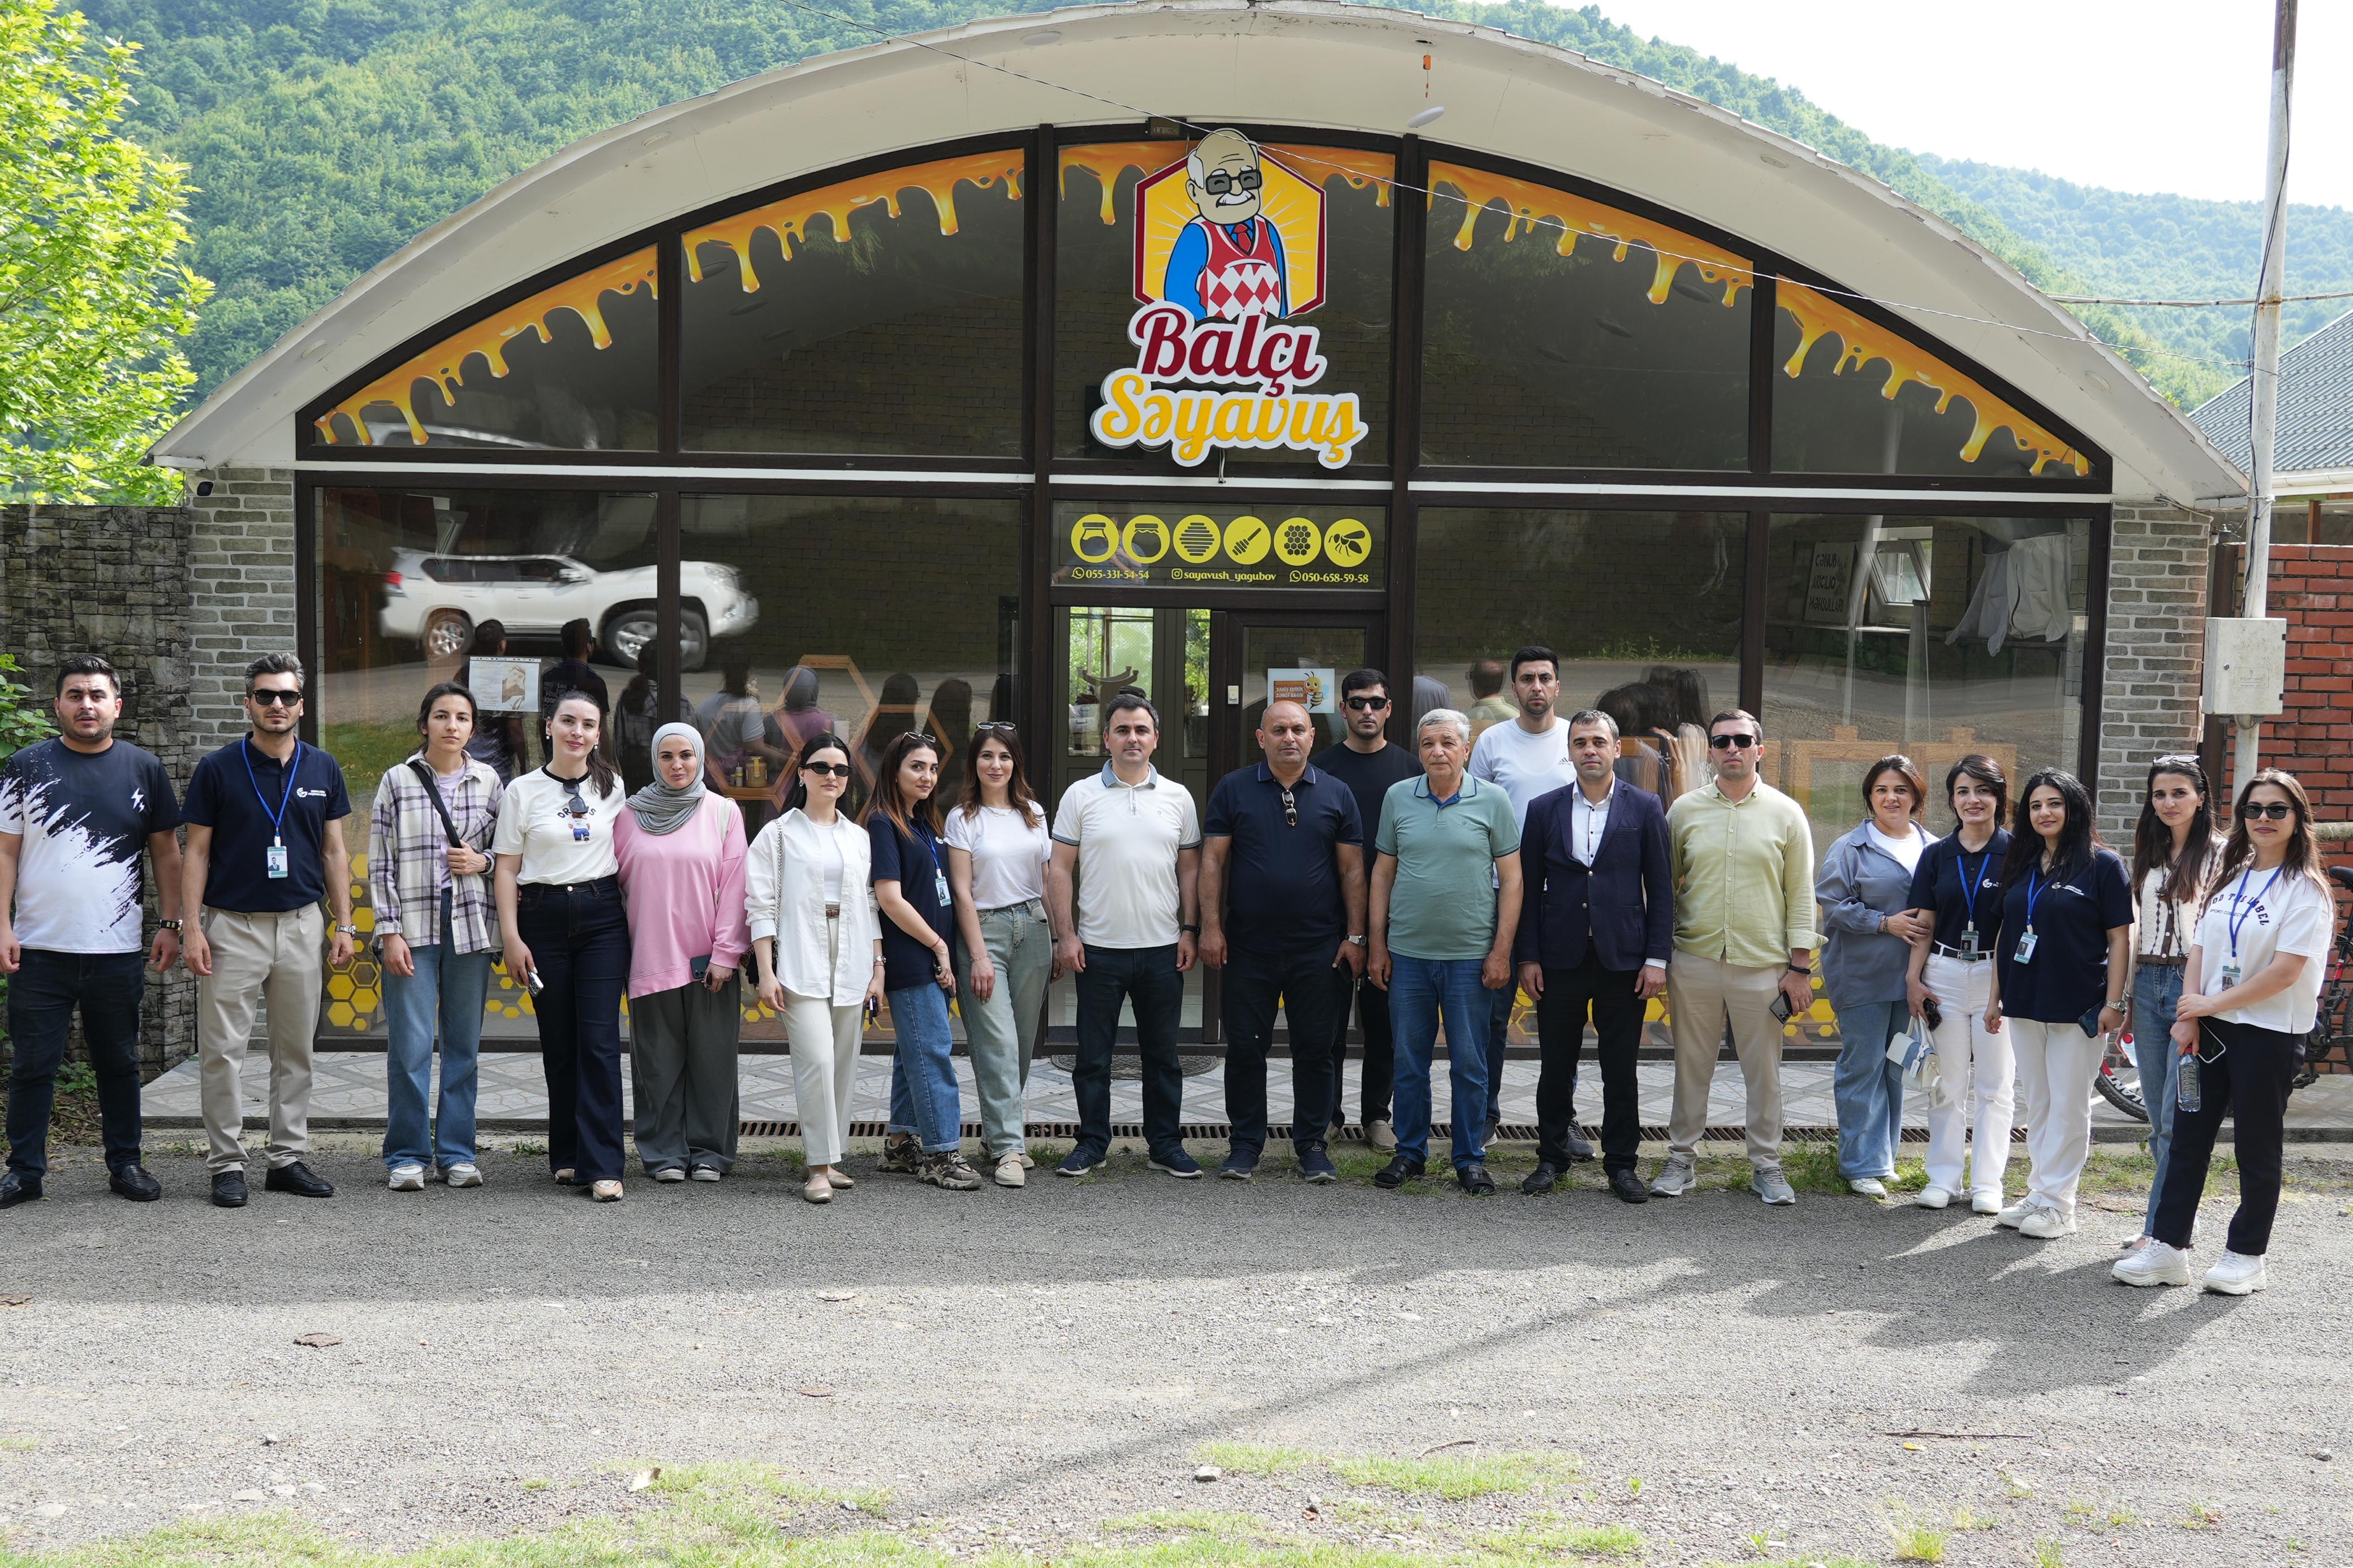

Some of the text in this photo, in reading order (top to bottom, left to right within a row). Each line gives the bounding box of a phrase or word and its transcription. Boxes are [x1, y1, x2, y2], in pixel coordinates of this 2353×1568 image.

[1135, 308, 1320, 398] Balçı
[1101, 374, 1361, 463] Səyavuş
[1085, 569, 1149, 579] 055-331-54-54
[1184, 571, 1277, 582] sayavush_yagubov
[1302, 573, 1369, 583] 050-658-59-58
[2228, 893, 2247, 902] TE
